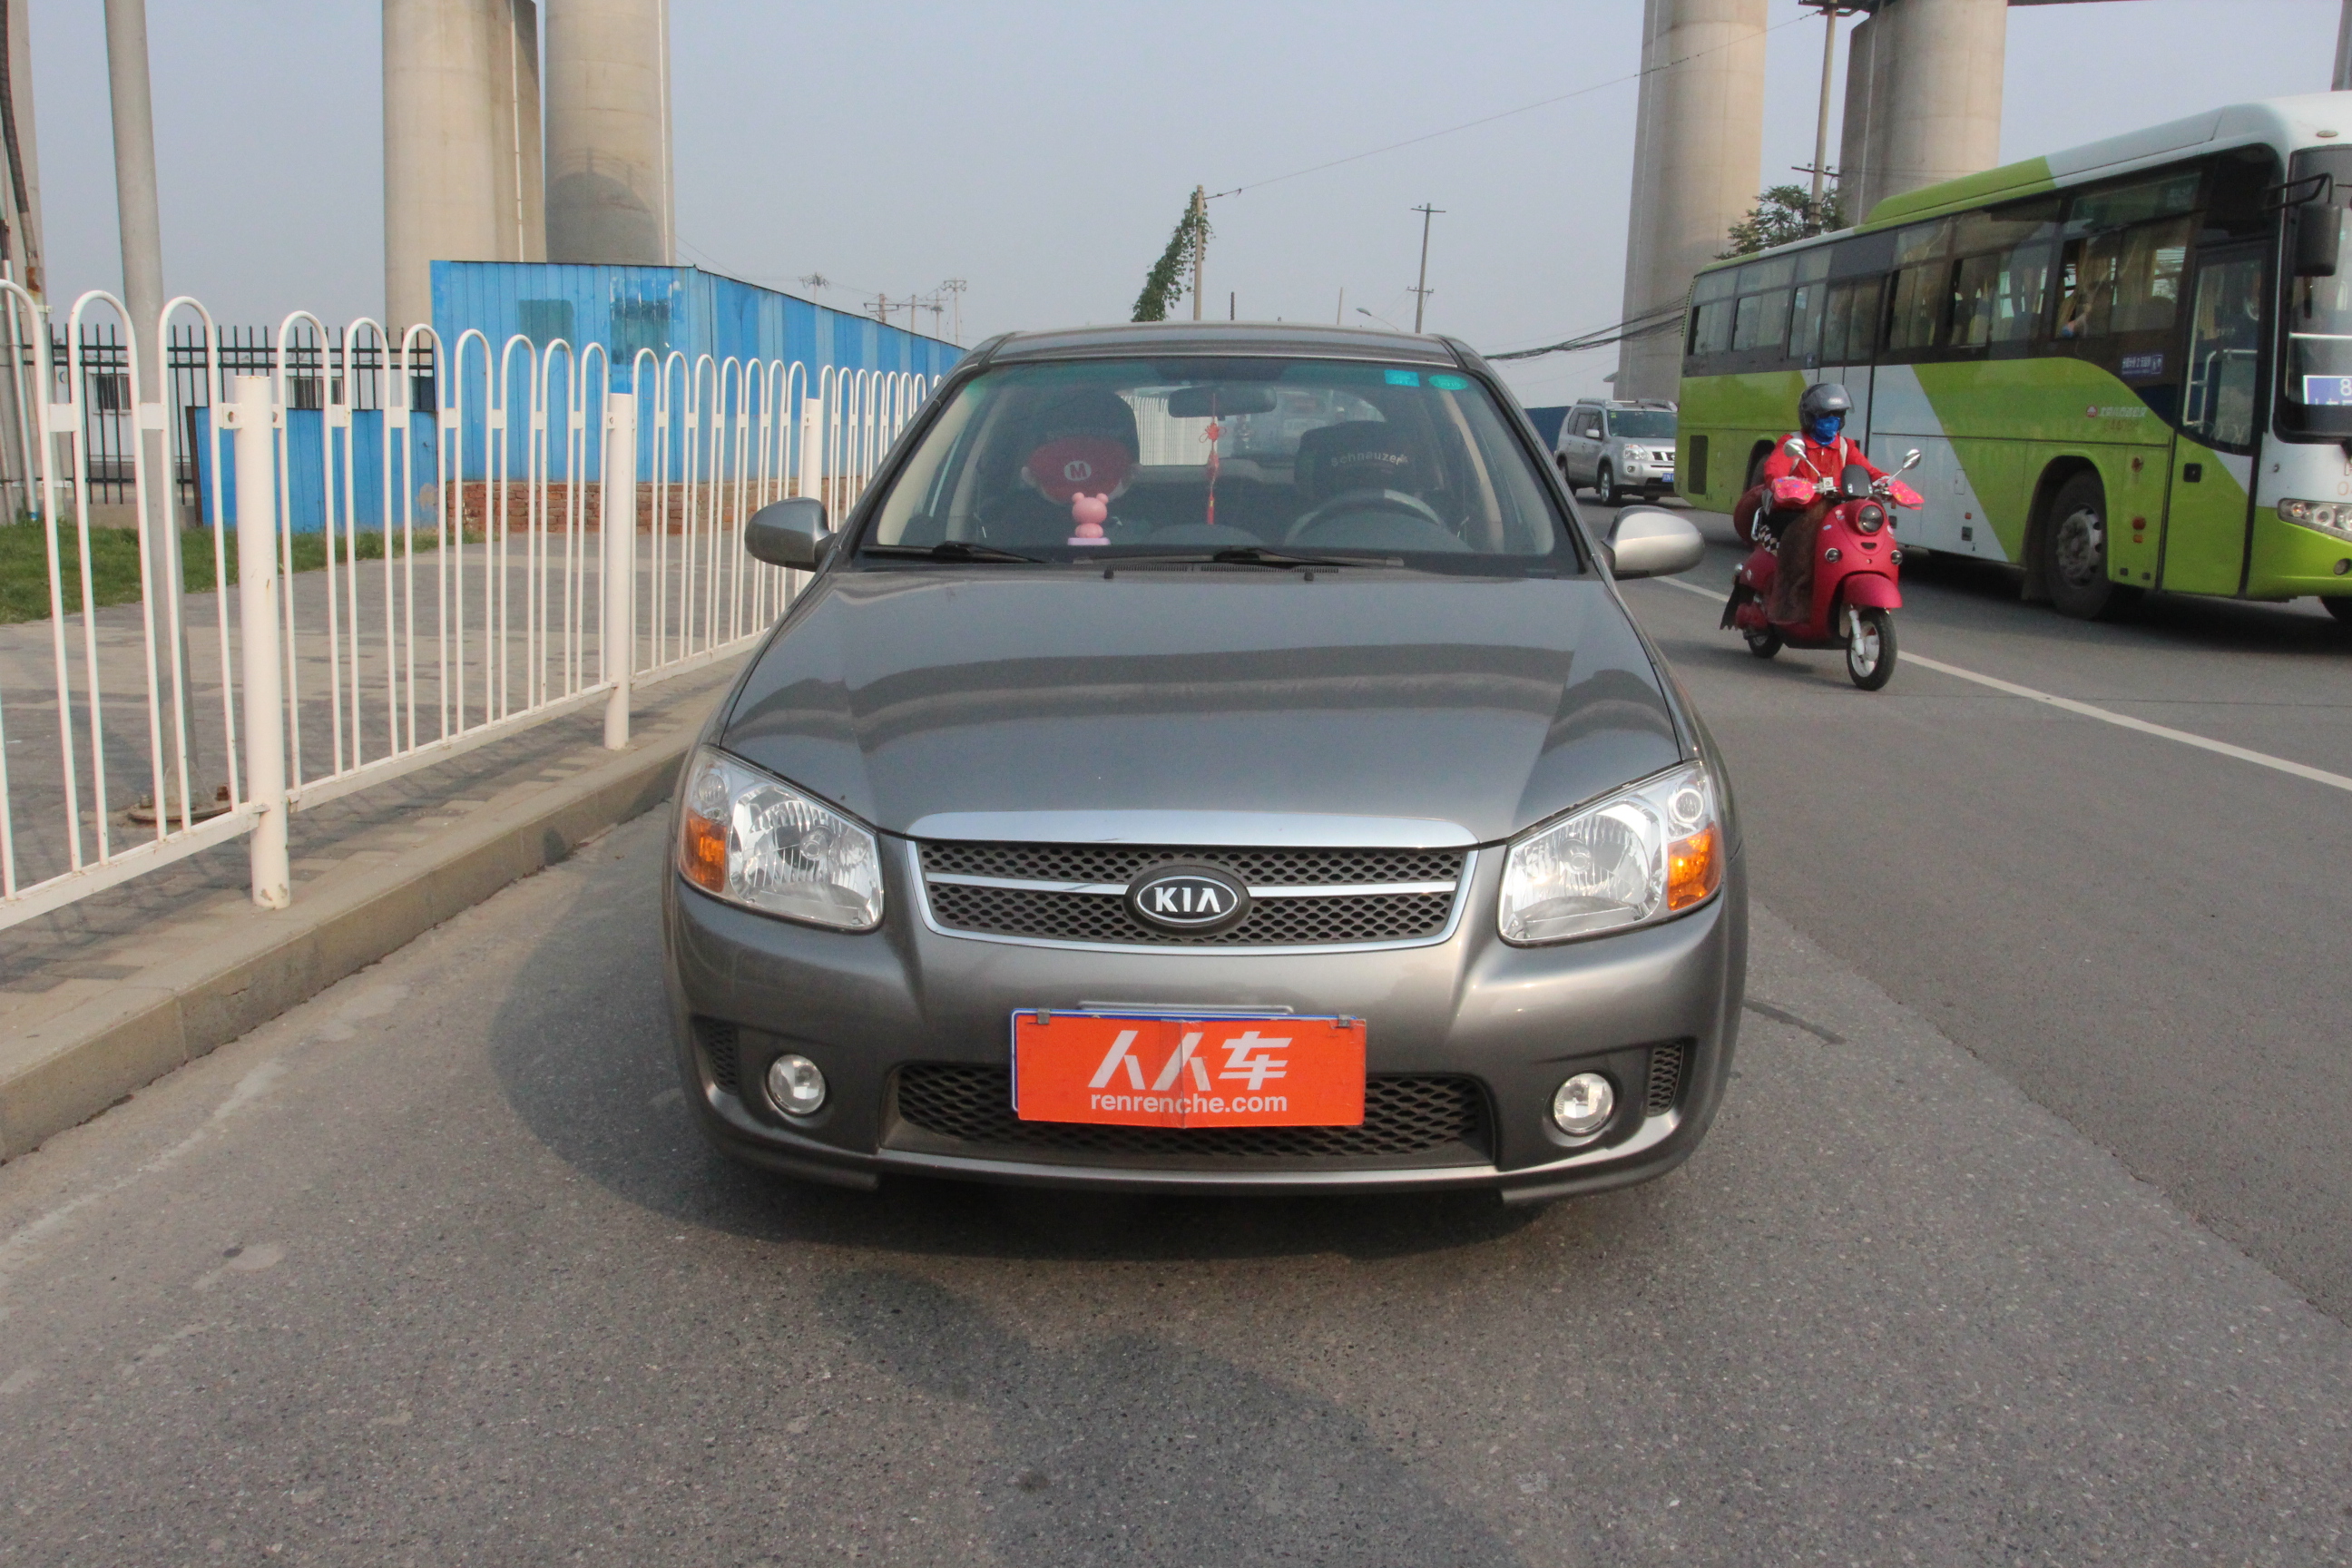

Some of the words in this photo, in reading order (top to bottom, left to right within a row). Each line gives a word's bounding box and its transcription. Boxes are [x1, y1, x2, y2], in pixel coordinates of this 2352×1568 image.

[1069, 462, 1088, 480] M
[1153, 887, 1221, 914] KIA
[1087, 1029, 1293, 1092] 人人车
[1091, 1093, 1289, 1114] renrenche.com
